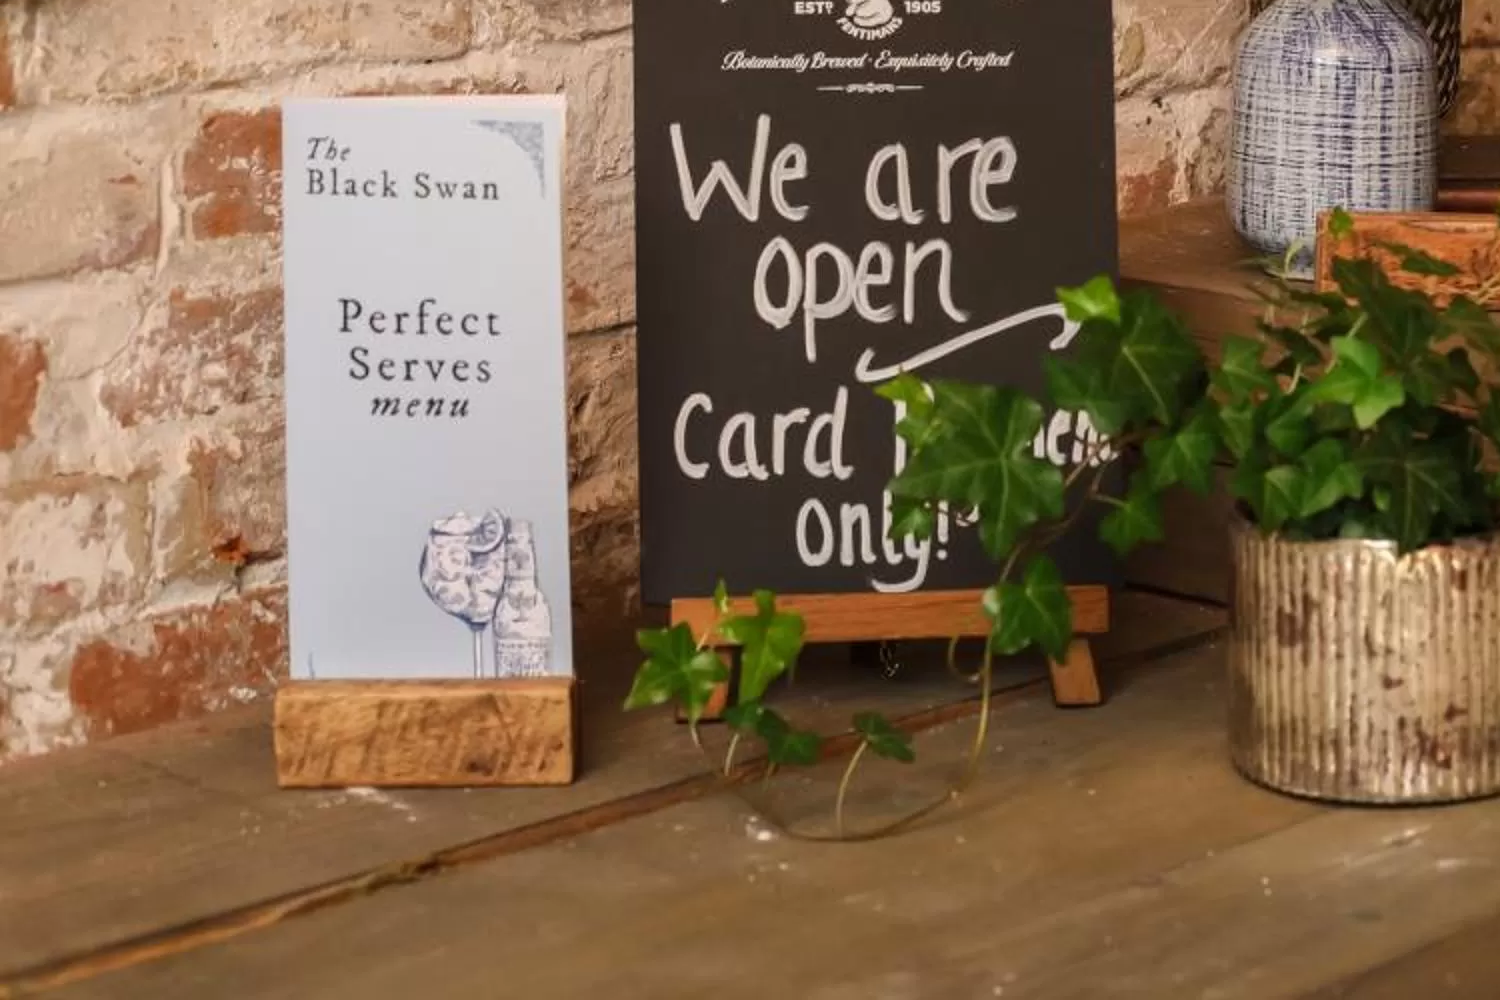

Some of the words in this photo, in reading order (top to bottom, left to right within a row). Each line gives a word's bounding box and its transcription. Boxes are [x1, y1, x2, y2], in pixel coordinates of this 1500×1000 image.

[904, 0, 942, 14] 1905
[836, 16, 903, 41] FENTIMANS
[720, 49, 810, 73] Botanically
[810, 51, 867, 70] Brewed
[874, 50, 954, 73] Exquisitely
[956, 49, 1012, 71] Crafted
[307, 136, 352, 162] The
[669, 113, 811, 222] We
[865, 136, 1018, 225] are
[306, 168, 399, 199] Black
[414, 172, 500, 201] Swan
[338, 298, 502, 336] Perfect
[348, 346, 493, 384] Serves
[370, 395, 470, 418] menu
[673, 385, 856, 481] Card
